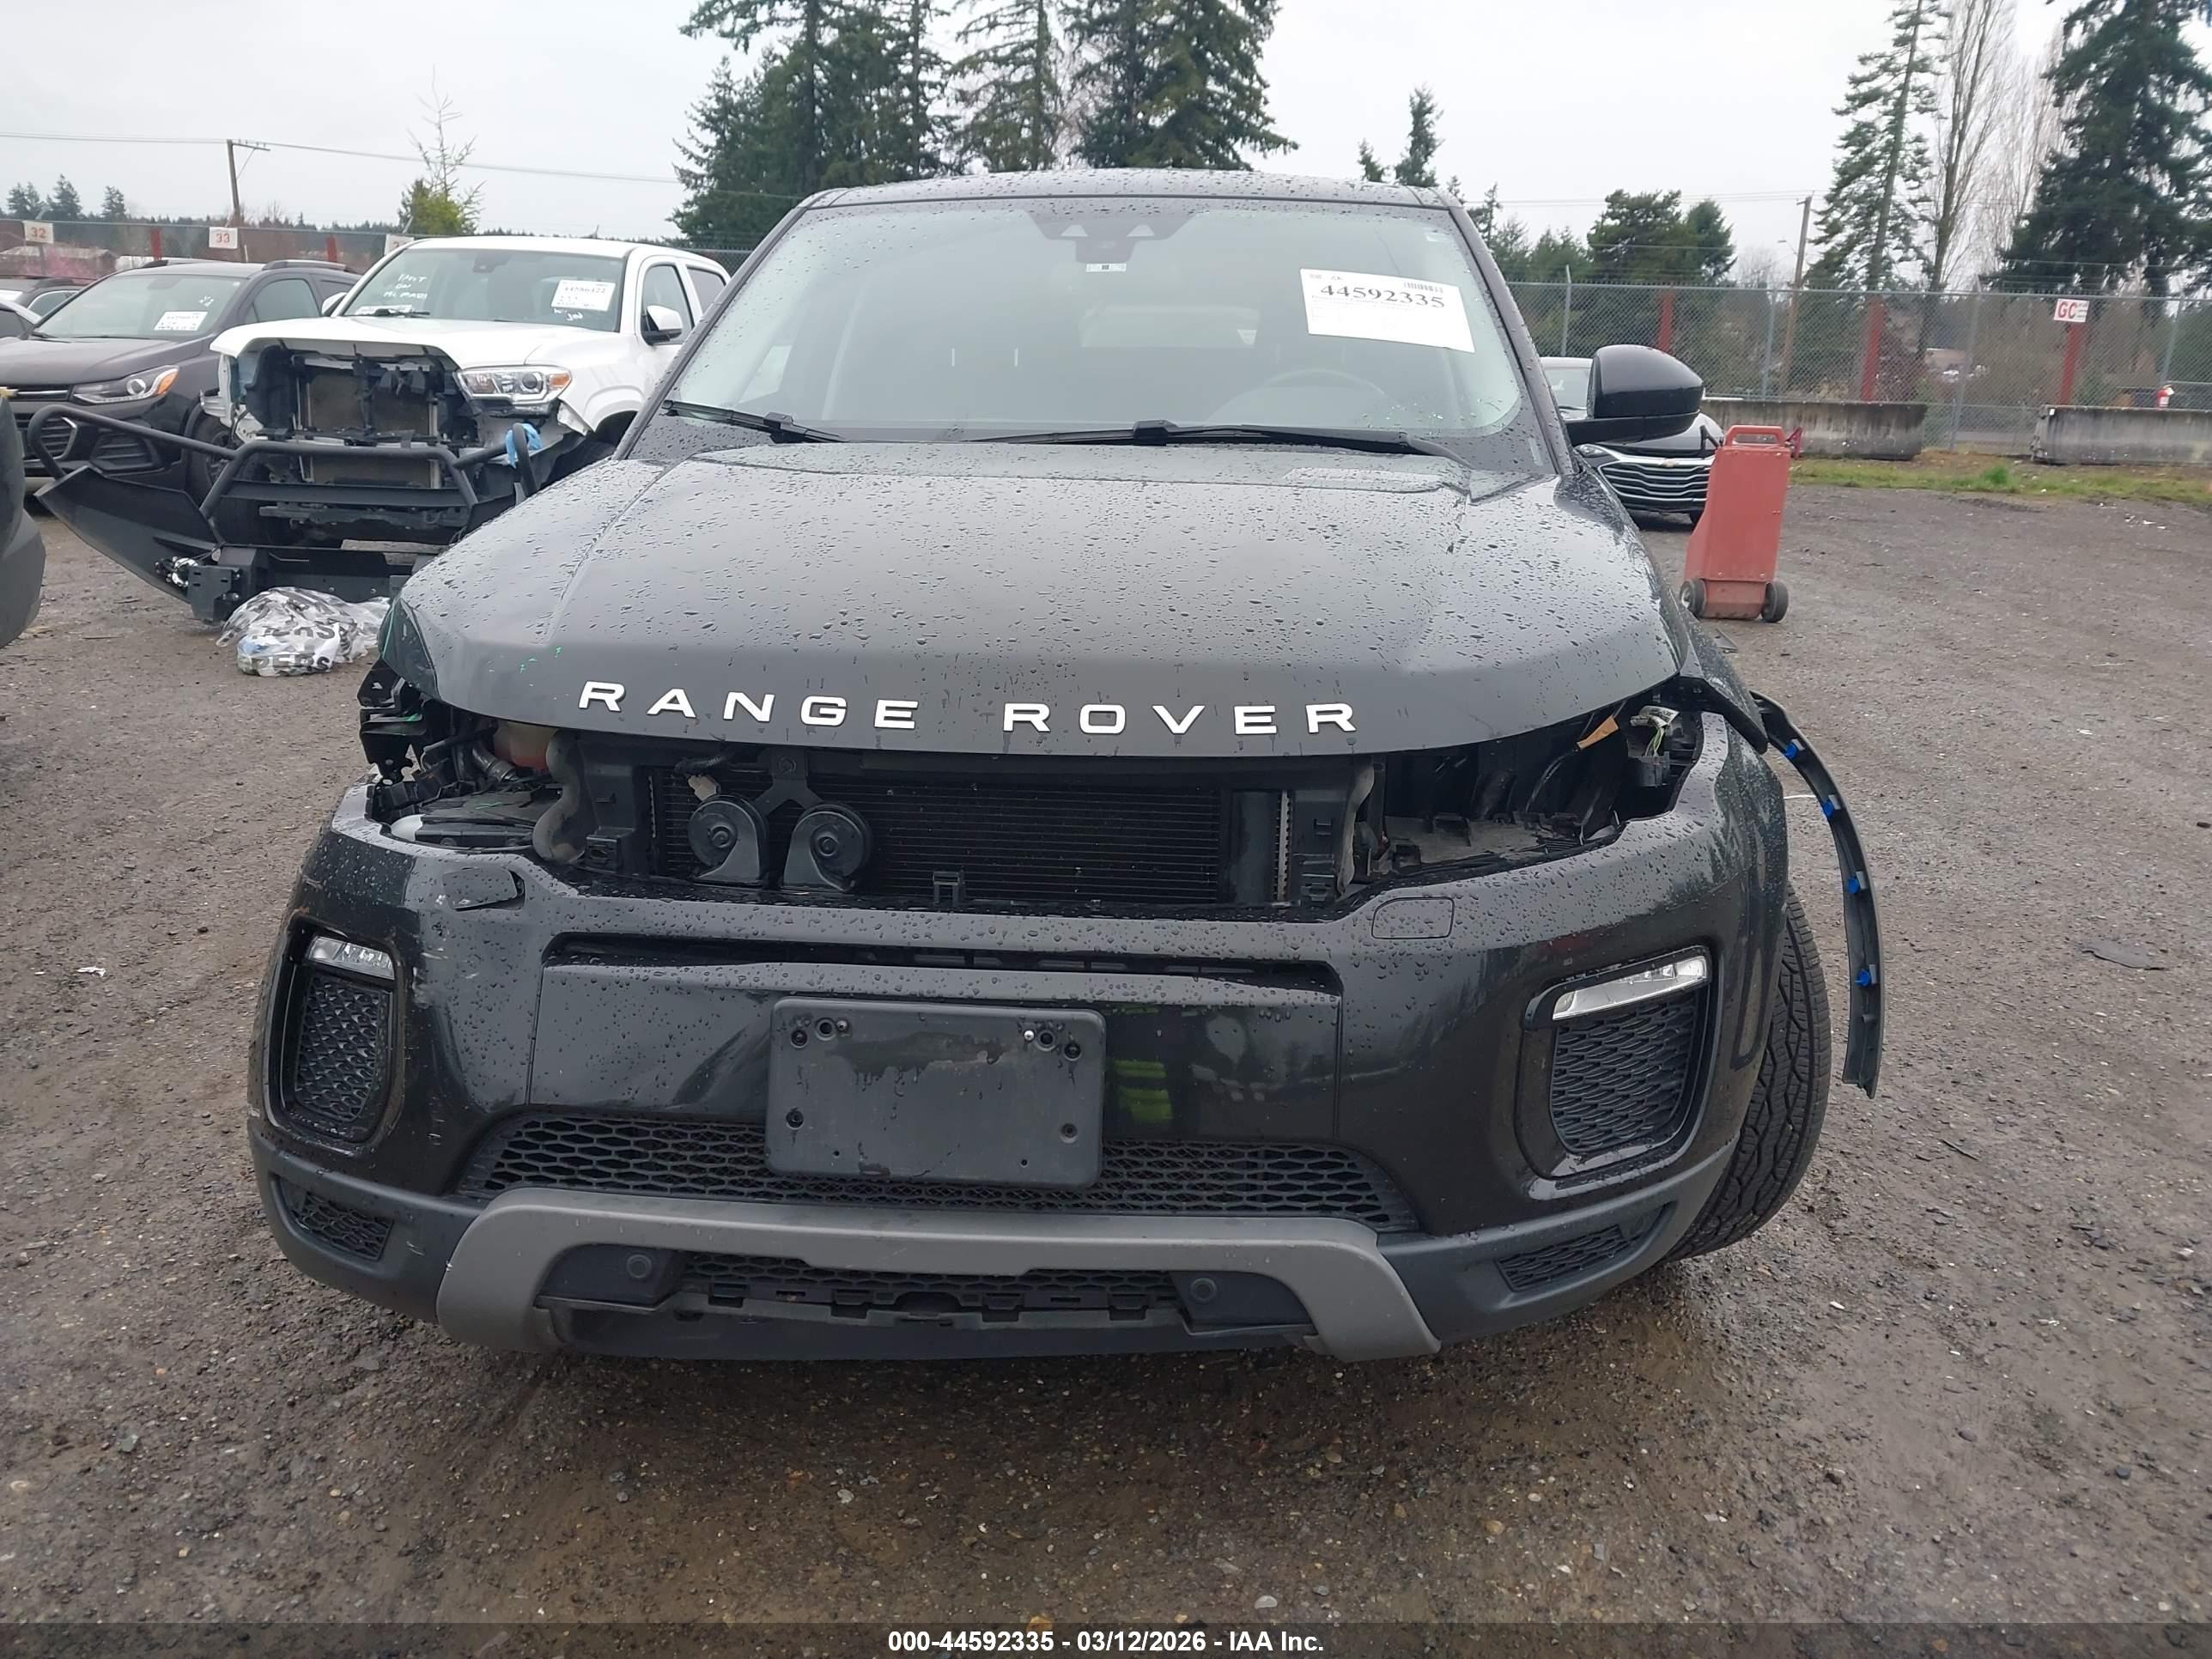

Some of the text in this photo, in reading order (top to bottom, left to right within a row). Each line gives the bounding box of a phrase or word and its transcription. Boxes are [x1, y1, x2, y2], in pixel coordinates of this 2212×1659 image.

[31, 227, 46, 239] 32
[216, 233, 230, 243] 33
[1321, 284, 1445, 308] 44592335
[2058, 301, 2078, 319] GC
[579, 681, 1356, 734] RANGE ROVER
